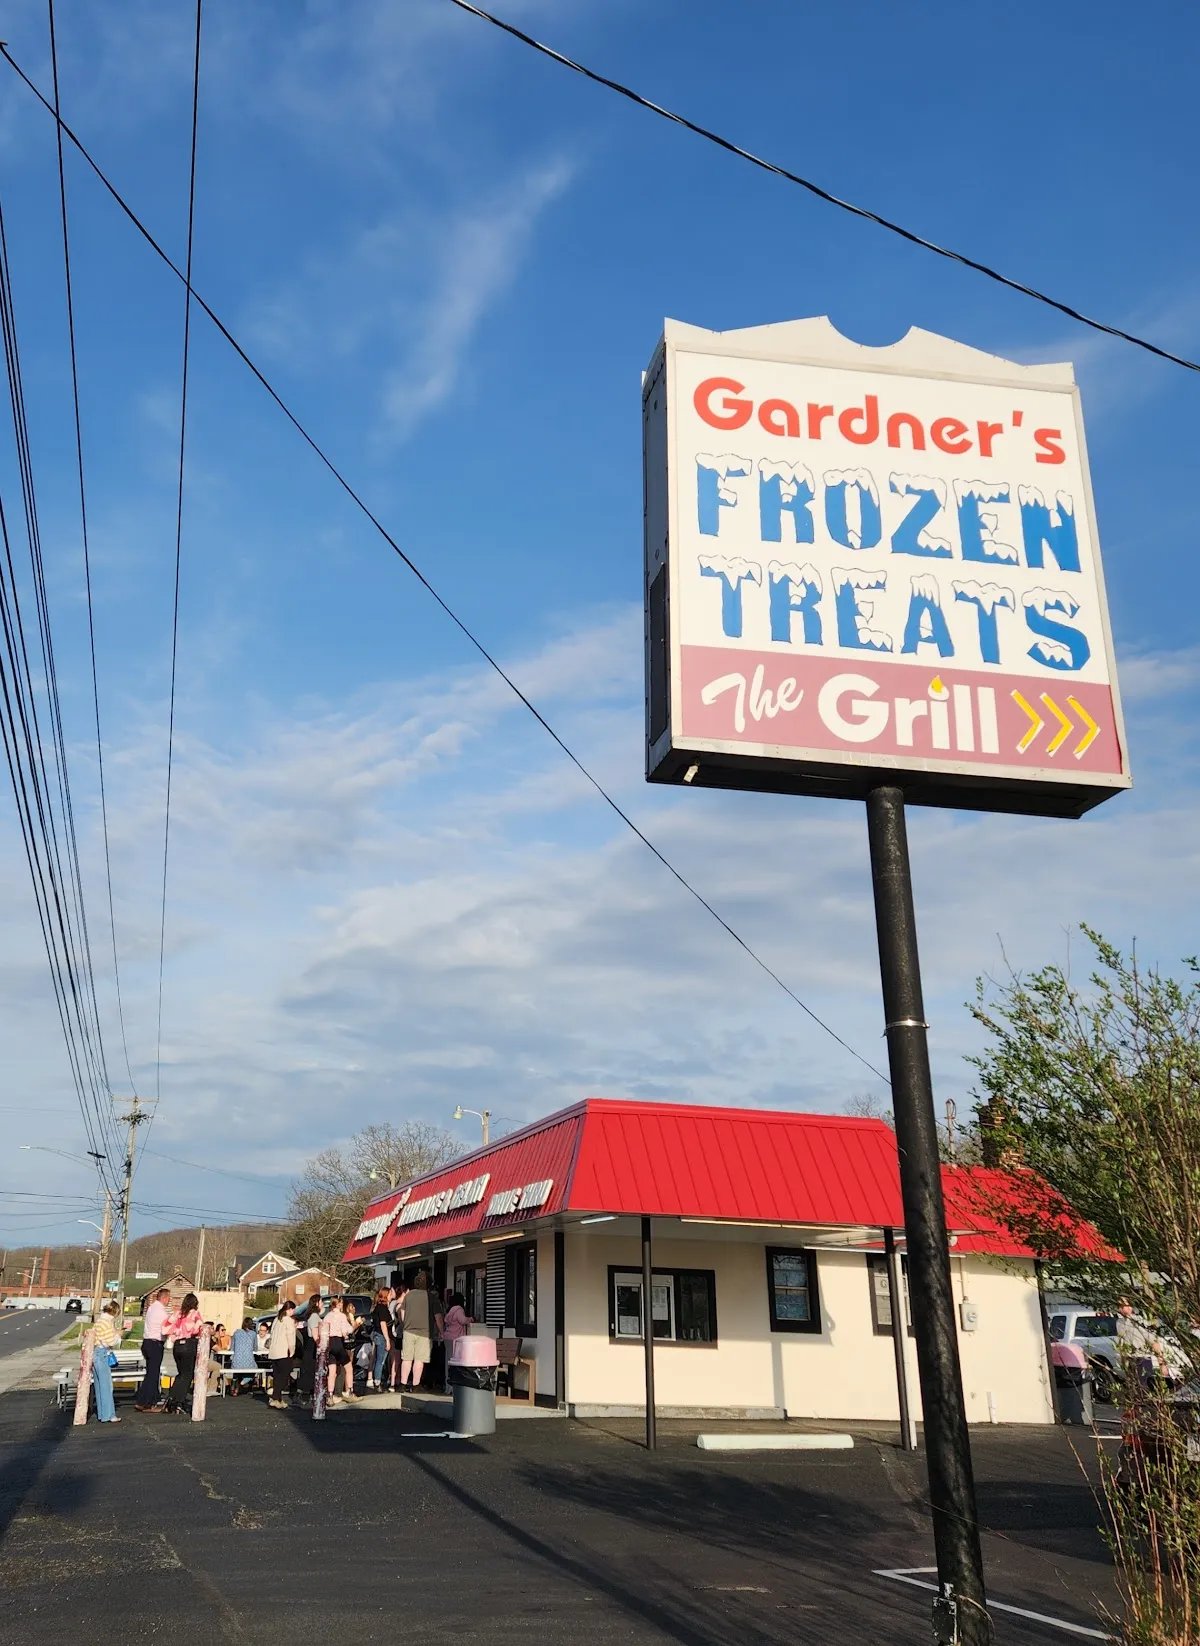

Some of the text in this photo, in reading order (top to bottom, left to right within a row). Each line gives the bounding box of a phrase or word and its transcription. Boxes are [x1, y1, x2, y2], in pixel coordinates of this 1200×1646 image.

[693, 376, 1067, 465] Gardner's
[695, 453, 1082, 573] FROZEN
[697, 554, 1091, 671] TREATS
[701, 664, 999, 754] The Grill
